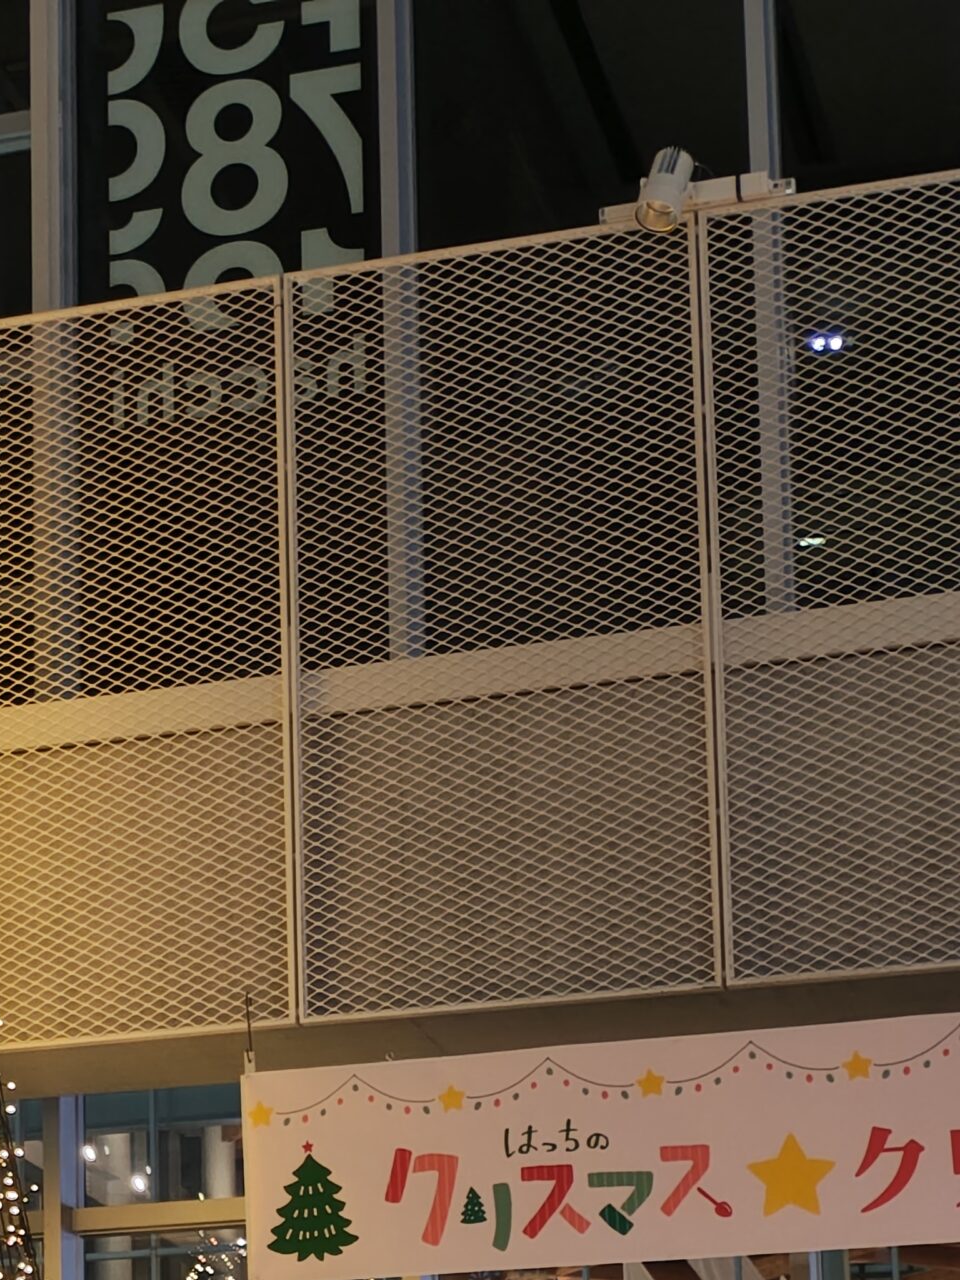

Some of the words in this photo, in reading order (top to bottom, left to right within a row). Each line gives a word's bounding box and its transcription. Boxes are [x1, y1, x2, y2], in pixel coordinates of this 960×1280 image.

[504, 1119, 610, 1158] はっちの
[385, 1144, 733, 1251] クリスマス
[855, 1126, 960, 1213] ク
